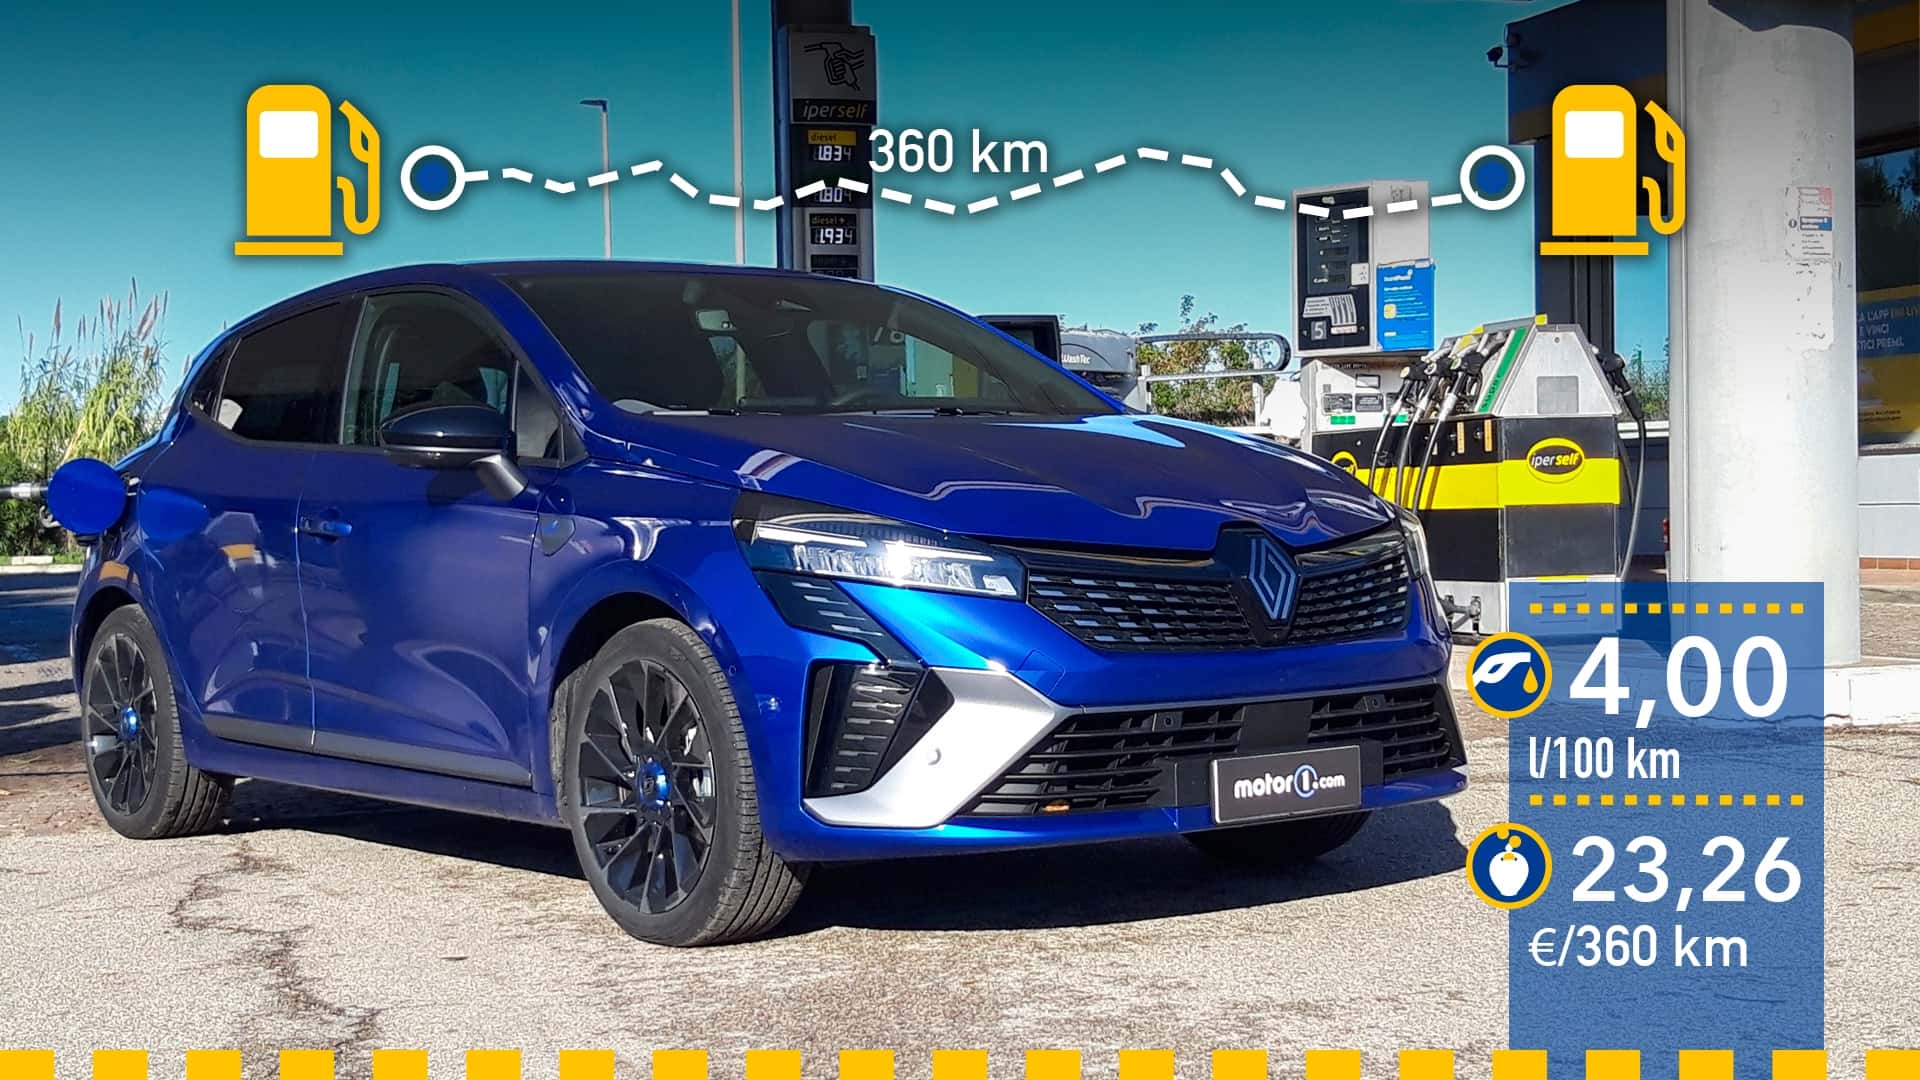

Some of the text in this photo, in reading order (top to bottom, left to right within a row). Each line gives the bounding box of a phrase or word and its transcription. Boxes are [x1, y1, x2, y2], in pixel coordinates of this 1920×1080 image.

[803, 101, 868, 120] iperself
[1314, 322, 1325, 339] 5
[1531, 452, 1579, 468] iperself
[1233, 764, 1345, 798] motor1.com
